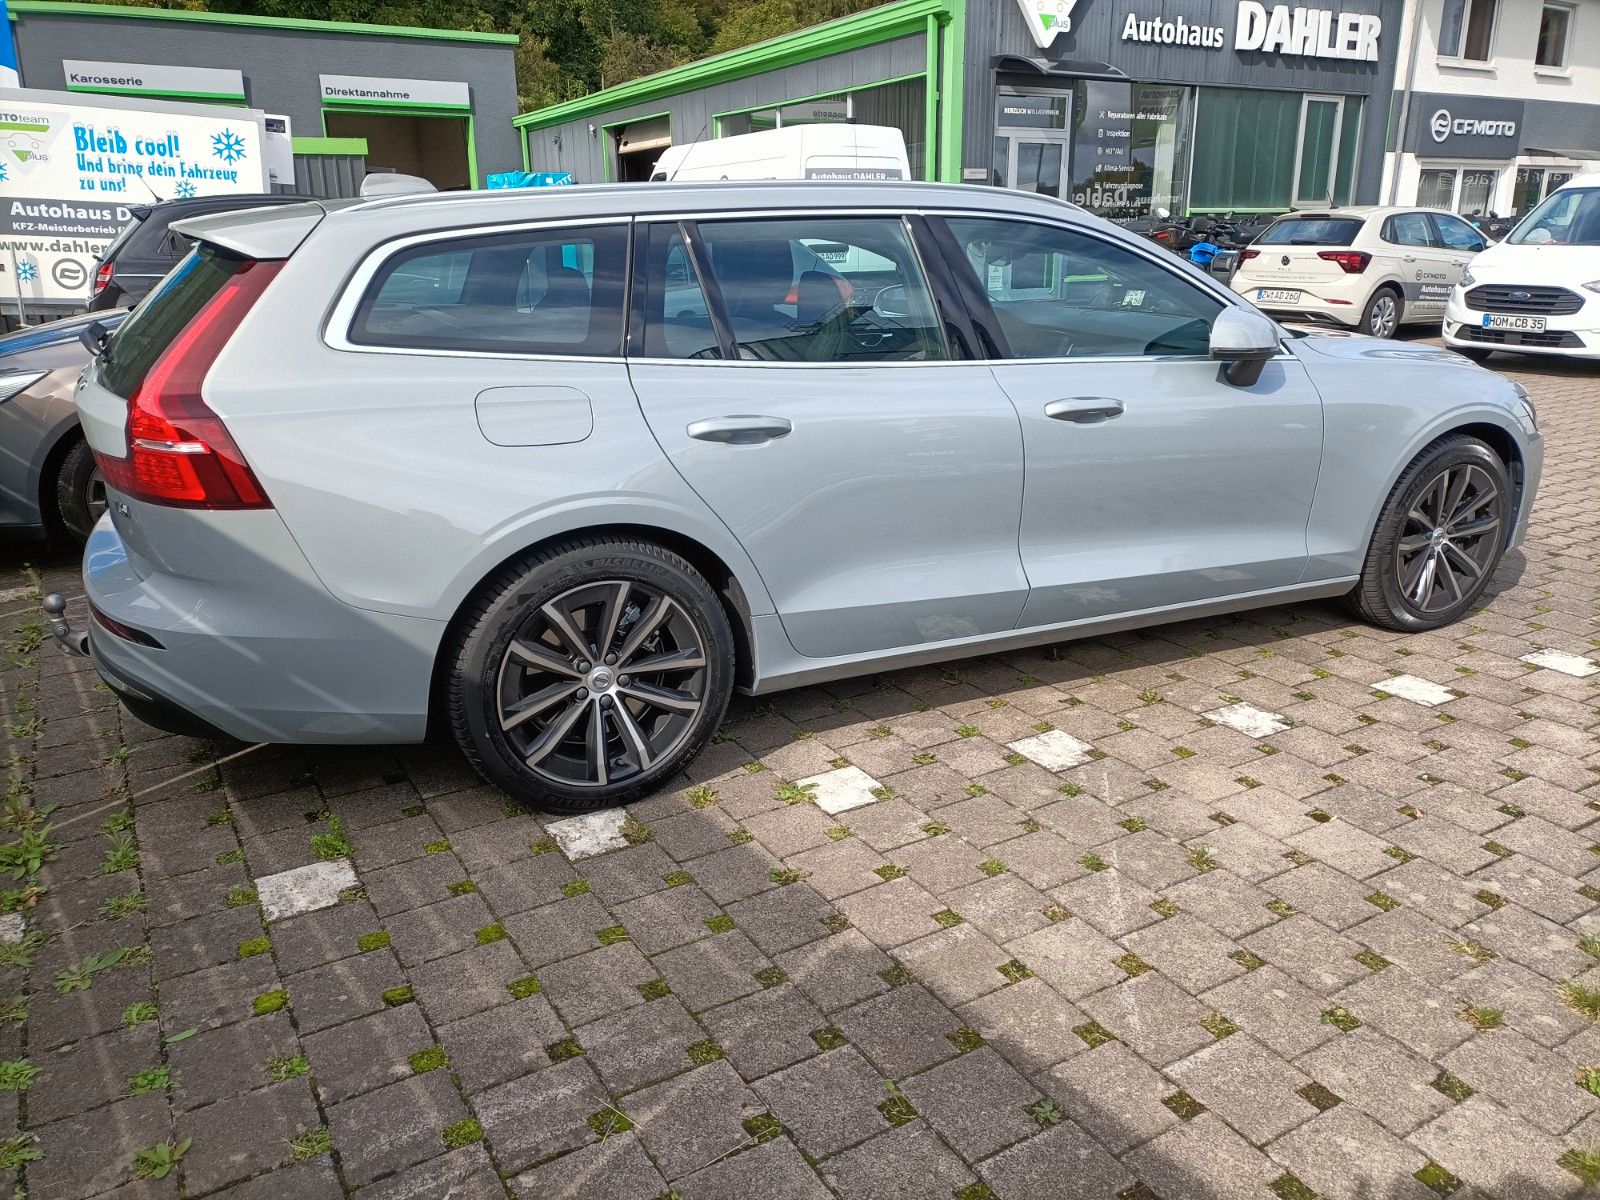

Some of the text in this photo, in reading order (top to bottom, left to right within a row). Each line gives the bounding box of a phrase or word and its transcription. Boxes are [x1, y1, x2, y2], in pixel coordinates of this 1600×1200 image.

[1122, 0, 1382, 61] Autohaus DAHLER
[70, 73, 143, 87] Karosserie
[325, 86, 410, 99] Direktannahme
[1106, 129, 1130, 138] Inspektion
[1453, 118, 1516, 137] CFMOTO
[73, 123, 180, 158] Bleib cool!
[76, 153, 237, 184] Und bring dein Fahrzeug
[811, 172, 852, 180] Autohaus
[853, 172, 886, 180] DAHLER
[79, 177, 126, 192] zu uns!
[10, 201, 111, 219] Autohaus
[12, 221, 115, 233] KFZ-Meisterbetrieb
[1423, 272, 1447, 280] CFMOTO
[1420, 284, 1447, 293] Autohaus
[1489, 315, 1544, 330] HOM CB 35
